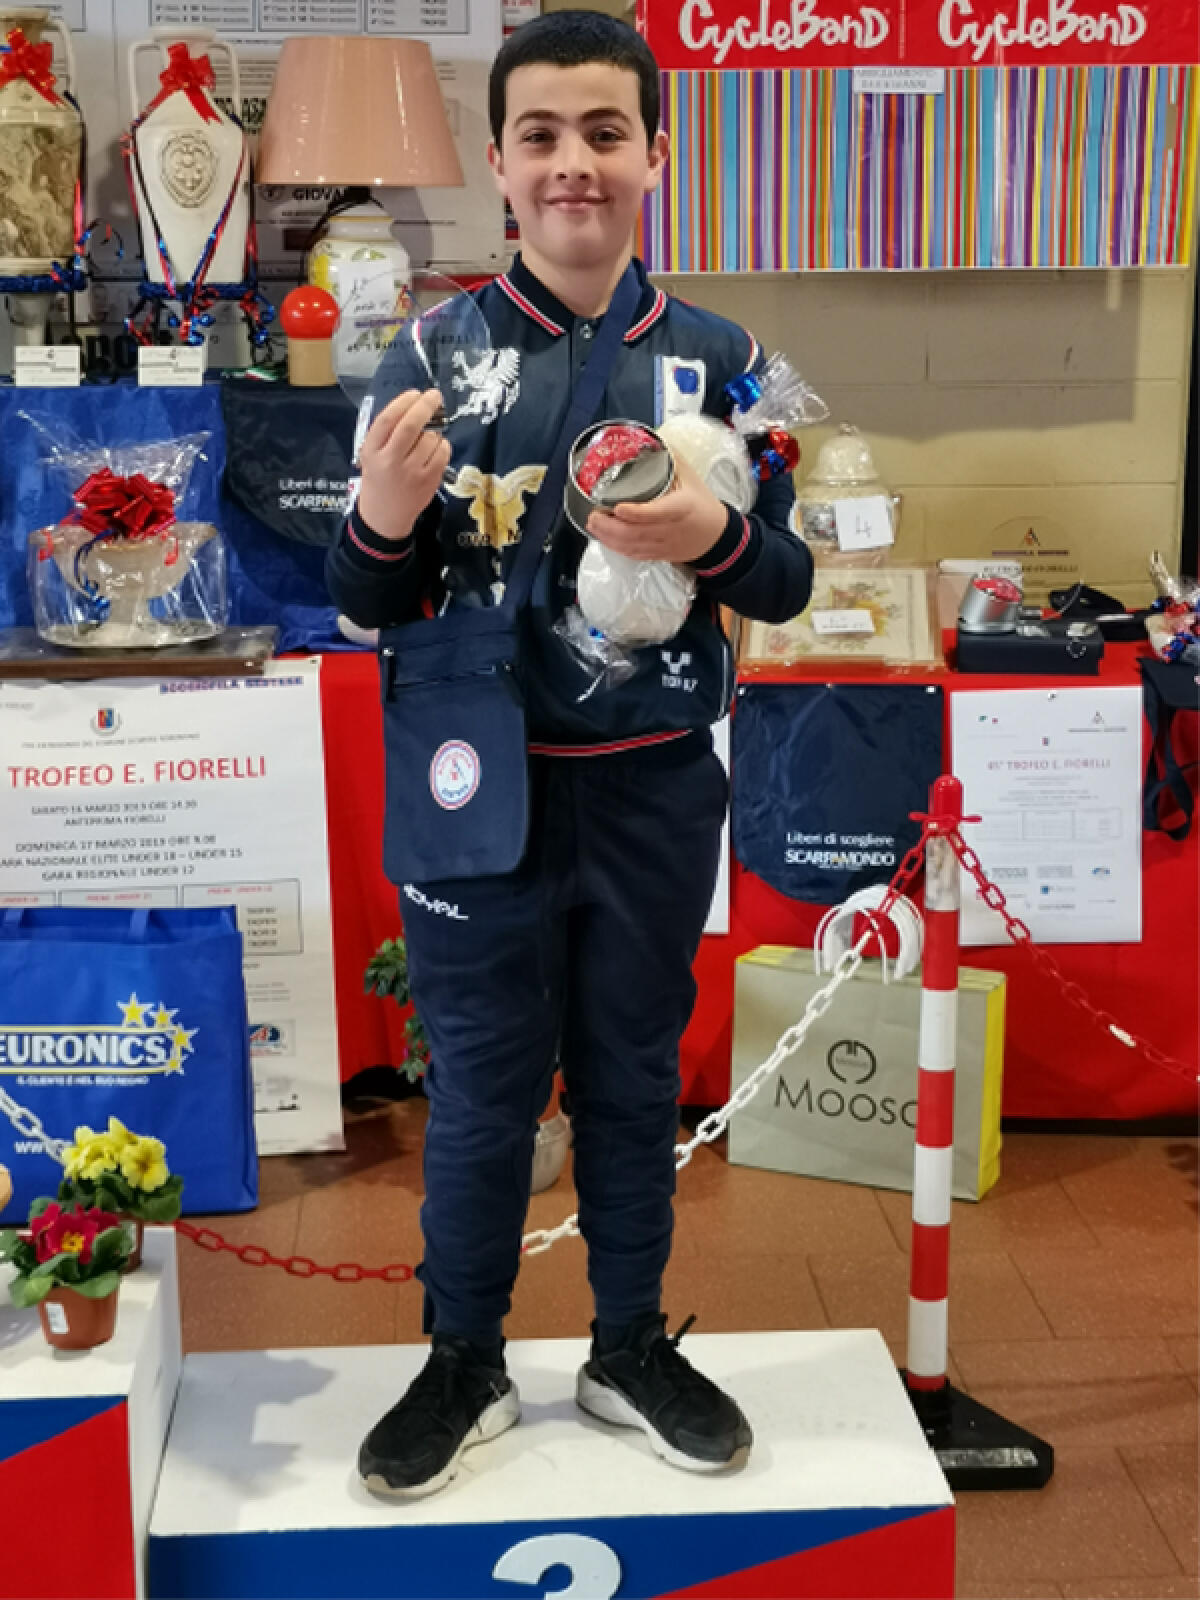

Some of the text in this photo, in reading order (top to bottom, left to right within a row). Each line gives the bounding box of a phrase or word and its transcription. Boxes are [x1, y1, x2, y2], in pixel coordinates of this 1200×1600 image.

[8, 755, 267, 789] TROFEO E. FIORELLI
